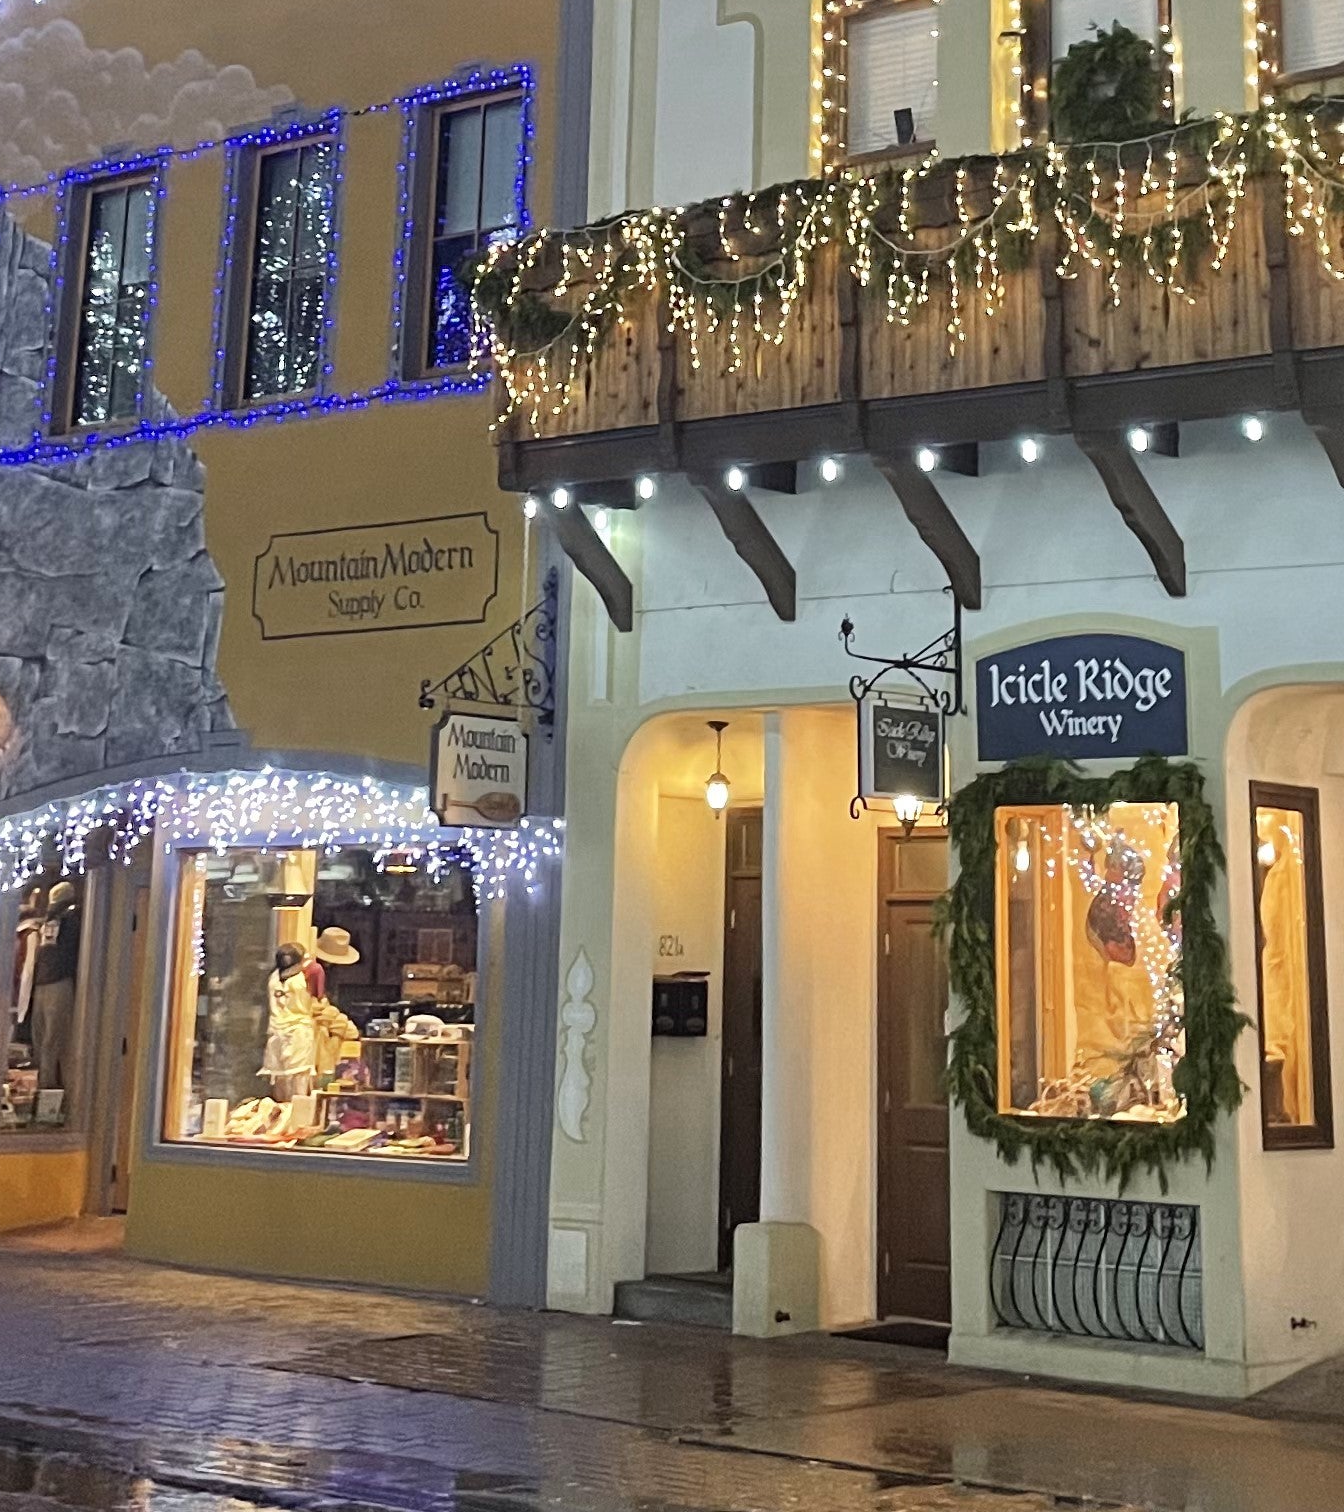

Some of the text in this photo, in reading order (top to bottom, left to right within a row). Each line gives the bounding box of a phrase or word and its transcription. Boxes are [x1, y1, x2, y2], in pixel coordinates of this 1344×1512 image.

[268, 538, 473, 589] Mountain Modern
[328, 586, 425, 621] Supply Co.
[989, 657, 1172, 712] Icicle Ridge
[447, 722, 515, 754] Mountain
[1039, 708, 1123, 743] Winery
[453, 753, 510, 783] Modern
